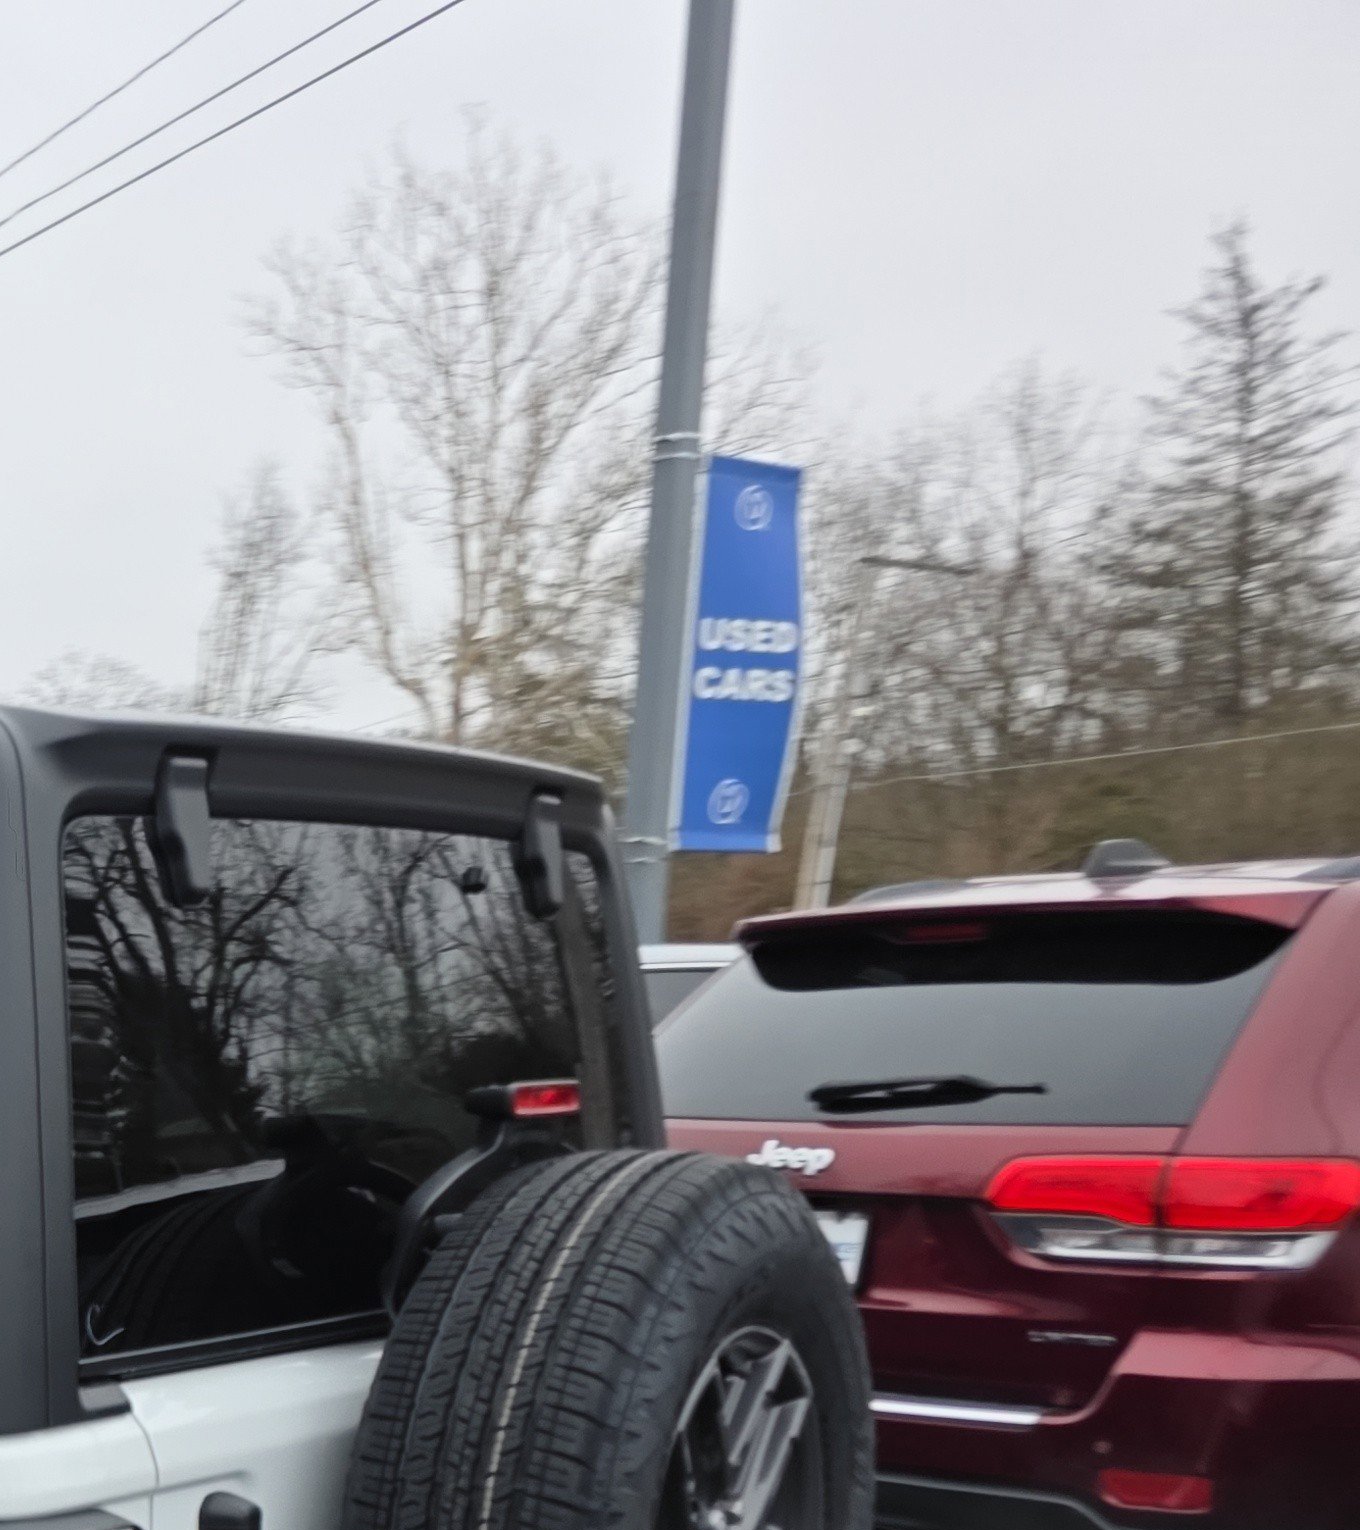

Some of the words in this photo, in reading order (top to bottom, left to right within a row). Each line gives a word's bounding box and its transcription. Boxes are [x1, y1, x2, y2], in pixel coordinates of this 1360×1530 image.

[699, 618, 798, 653] USED
[693, 666, 794, 702] CARS
[745, 1139, 836, 1176] Jeep
